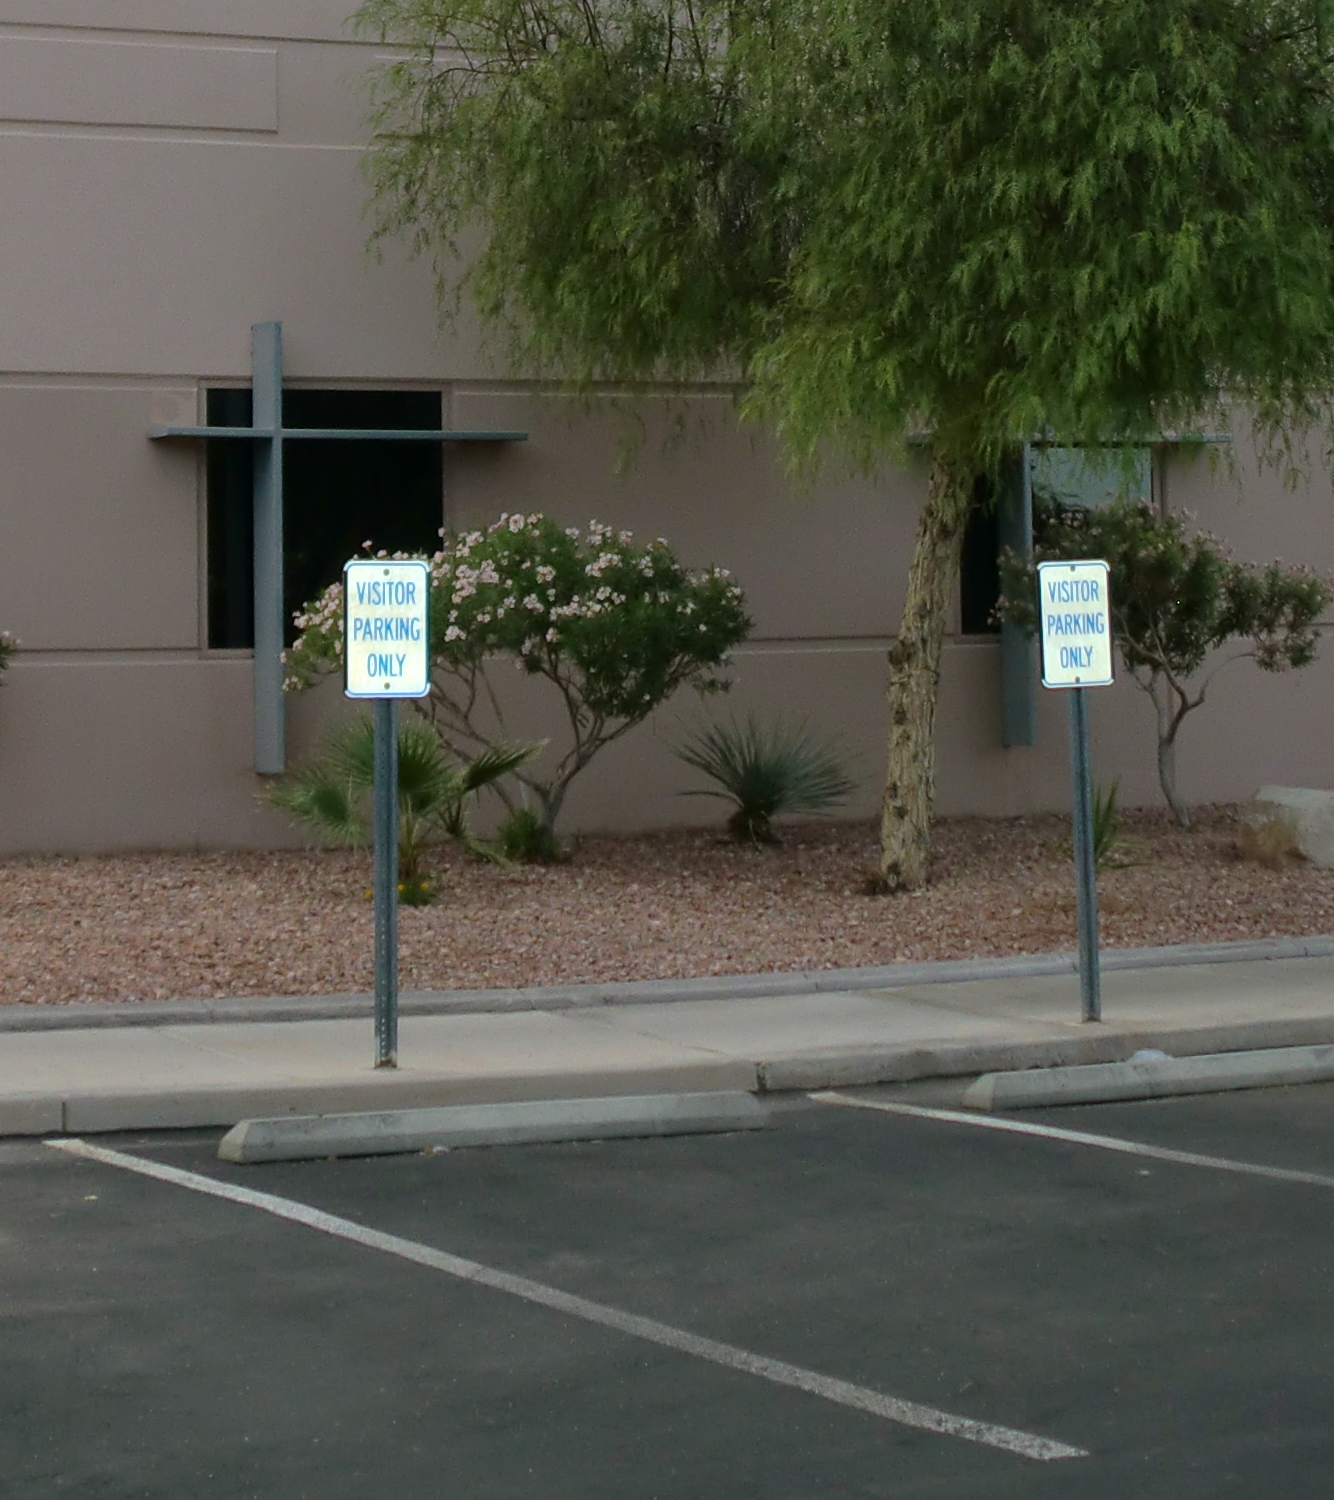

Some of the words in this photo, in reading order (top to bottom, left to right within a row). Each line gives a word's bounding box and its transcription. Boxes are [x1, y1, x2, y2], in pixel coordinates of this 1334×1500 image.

[356, 581, 416, 605] VISITOR
[1048, 580, 1099, 603] VISITOR
[353, 617, 420, 641] PARKING
[1047, 612, 1105, 636] PARKING
[367, 653, 406, 677] ONLY
[1060, 646, 1093, 669] ONLY
